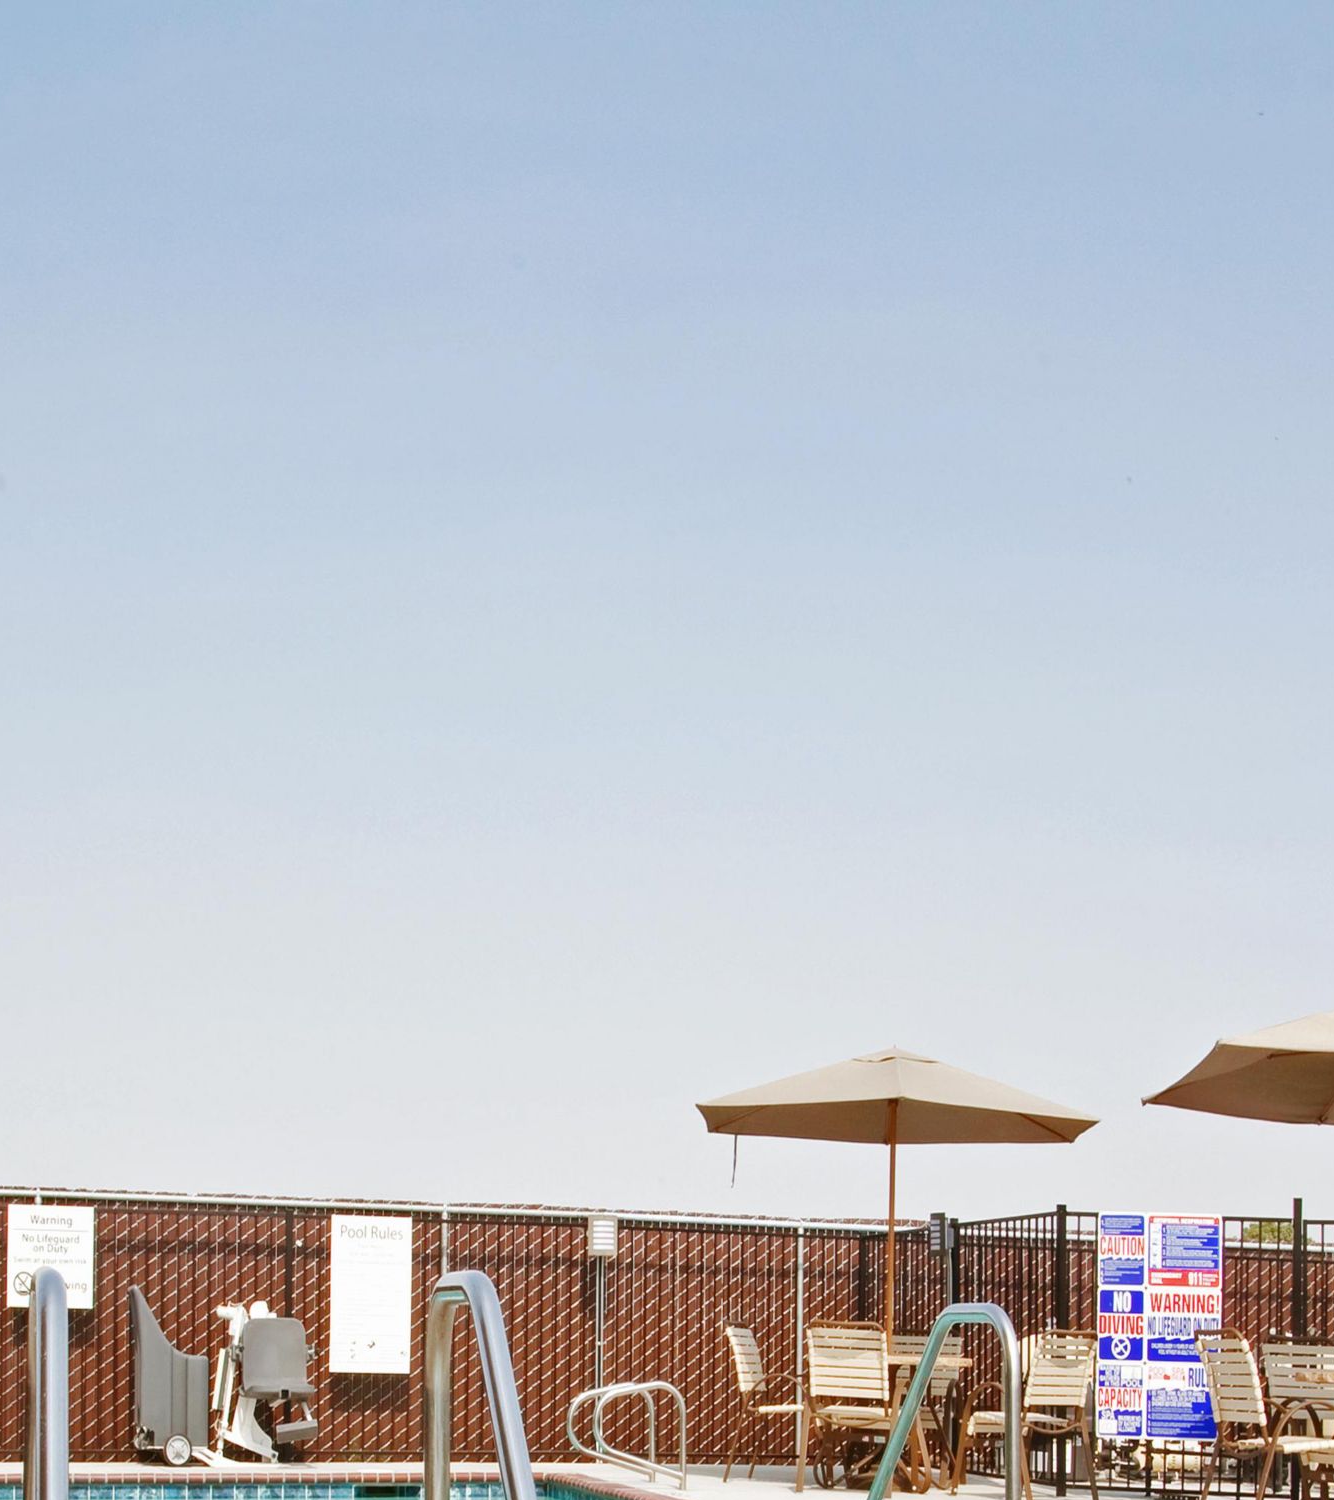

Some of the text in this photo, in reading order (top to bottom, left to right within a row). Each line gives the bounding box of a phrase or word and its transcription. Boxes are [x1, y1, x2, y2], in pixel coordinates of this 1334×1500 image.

[30, 1215, 73, 1228] Warning
[21, 1233, 80, 1245] No Lifeguard
[340, 1224, 404, 1240] Pool Rules
[33, 1243, 69, 1254] on Duty
[1099, 1236, 1145, 1256] CAUTION
[64, 1282, 88, 1293] ving
[1188, 1271, 1203, 1287] 911
[1113, 1291, 1132, 1313] NO
[1150, 1293, 1220, 1314] WARNING!
[1098, 1315, 1144, 1335] DIVING
[1147, 1316, 1156, 1336] NO
[1158, 1316, 1192, 1337] LIFEGUARD
[1188, 1367, 1208, 1388] RUL
[1098, 1388, 1143, 1409] CAPACITY
